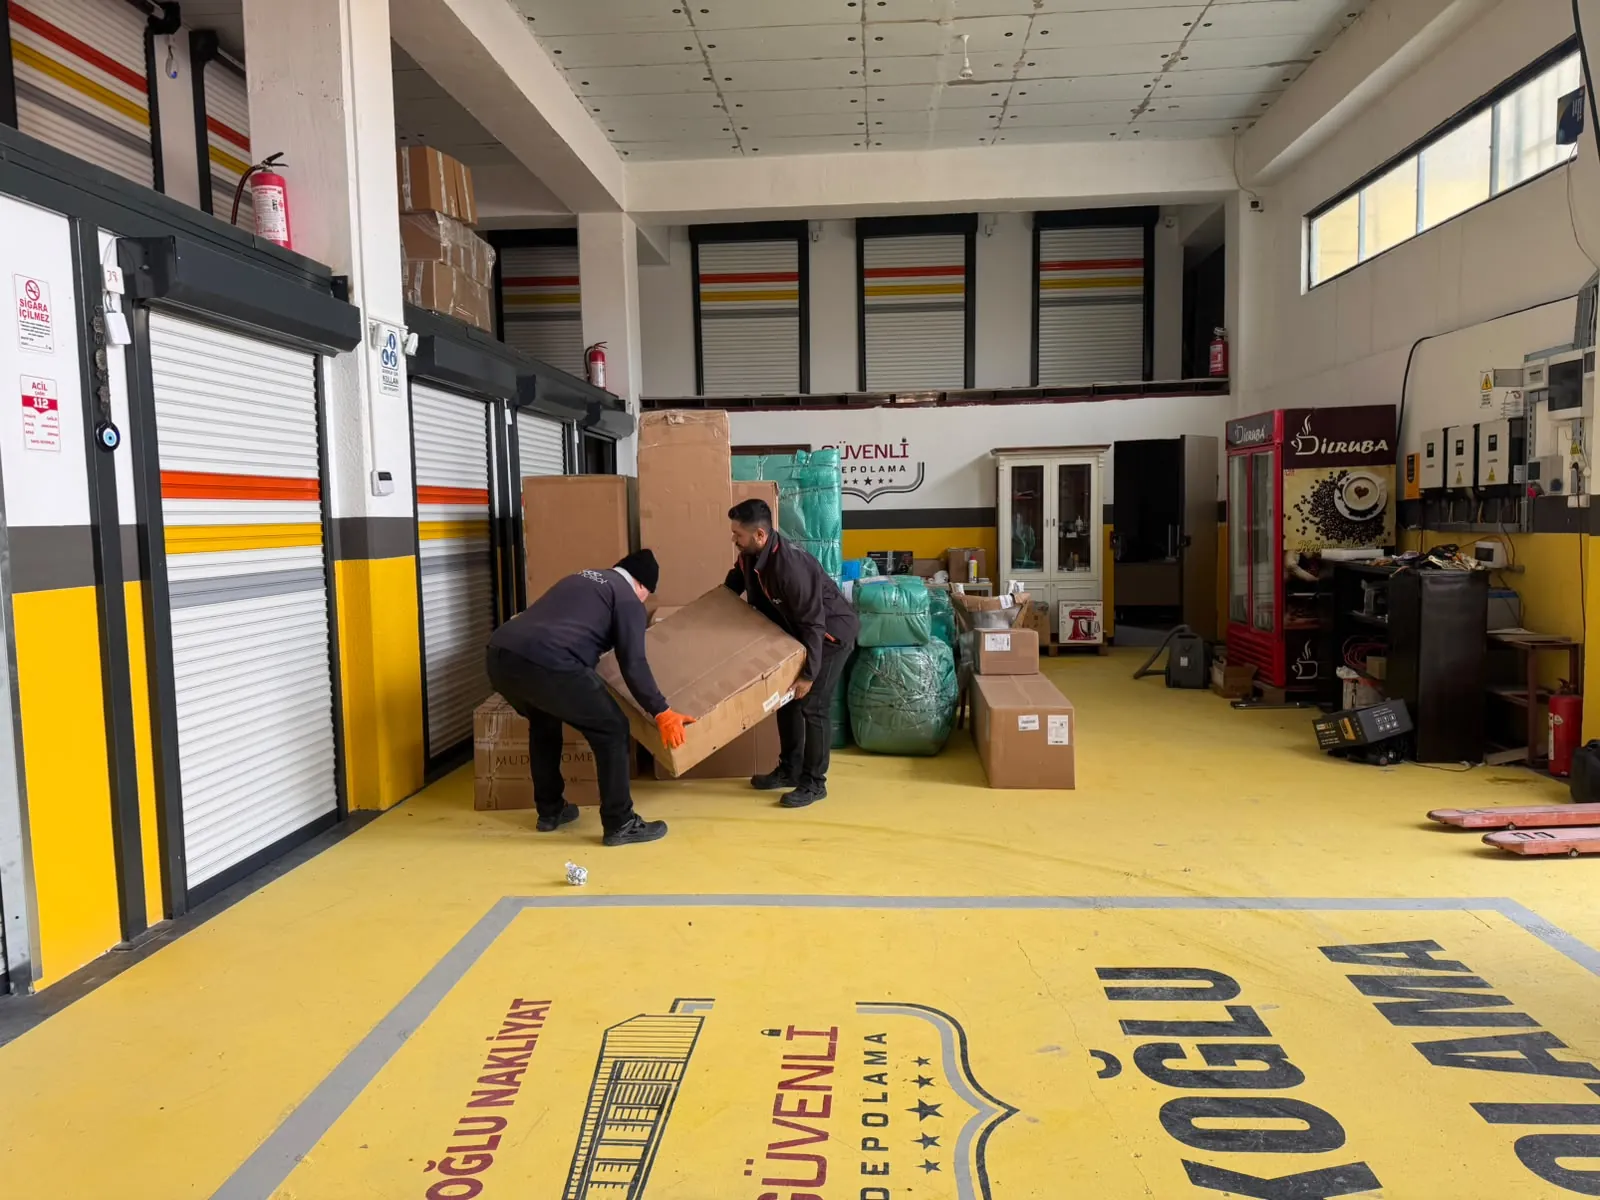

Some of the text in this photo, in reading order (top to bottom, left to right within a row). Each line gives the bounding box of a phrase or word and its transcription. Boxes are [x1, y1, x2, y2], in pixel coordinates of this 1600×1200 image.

[19, 297, 48, 312] SİGARA
[19, 307, 50, 323] İÇİLMEZ
[31, 381, 48, 391] ACİL
[33, 397, 49, 409] 112
[821, 437, 909, 460] ÜVENLİ
[841, 464, 906, 473] EPOLAMA
[496, 752, 593, 765] MUD OME
[466, 998, 552, 1108] NAKLİYAT
[744, 1025, 839, 1200] ÜVENLİ
[860, 1032, 890, 1200] DEPOLAMA
